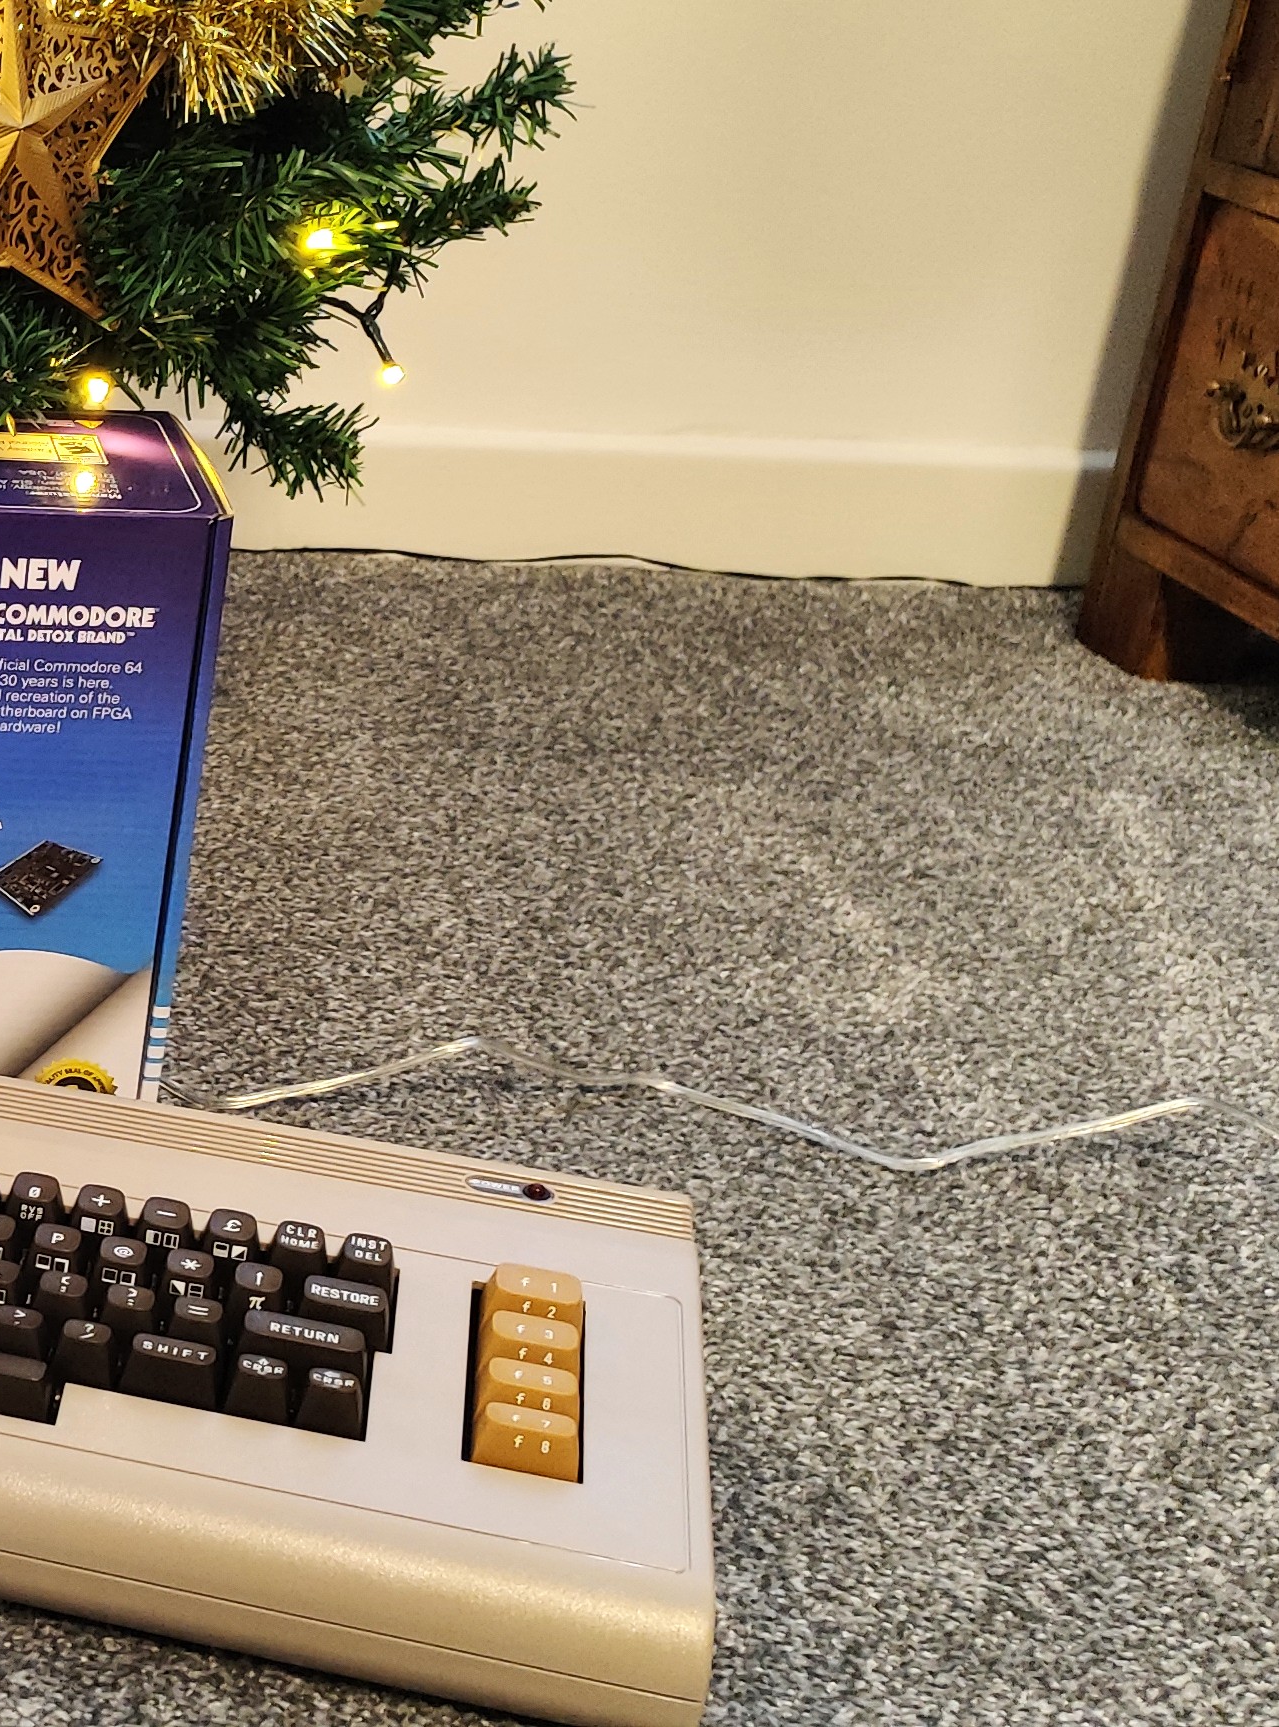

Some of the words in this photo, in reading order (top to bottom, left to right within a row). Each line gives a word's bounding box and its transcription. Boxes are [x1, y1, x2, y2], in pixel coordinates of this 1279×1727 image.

[27, 629, 74, 643] DETOX
[34, 659, 121, 674] Commodore
[124, 661, 143, 674] 64
[0, 674, 18, 687] 30
[21, 676, 59, 689] years
[62, 676, 74, 688] is
[78, 676, 114, 689] here.
[5, 689, 74, 704] recreation
[78, 691, 94, 705] of
[97, 692, 120, 705] the
[70, 709, 88, 720] on
[92, 707, 132, 720] FPGA
[19, 1211, 43, 1222] OFF
[20, 1203, 43, 1216] RVS
[50, 1232, 65, 1244] P
[285, 1224, 318, 1239] CLR
[280, 1235, 319, 1250] HOME
[351, 1235, 388, 1250] INST
[354, 1249, 383, 1263] DEL
[310, 1283, 380, 1307] RESTORE
[269, 1320, 341, 1345] RETURN
[142, 1340, 210, 1361] SHIFT
